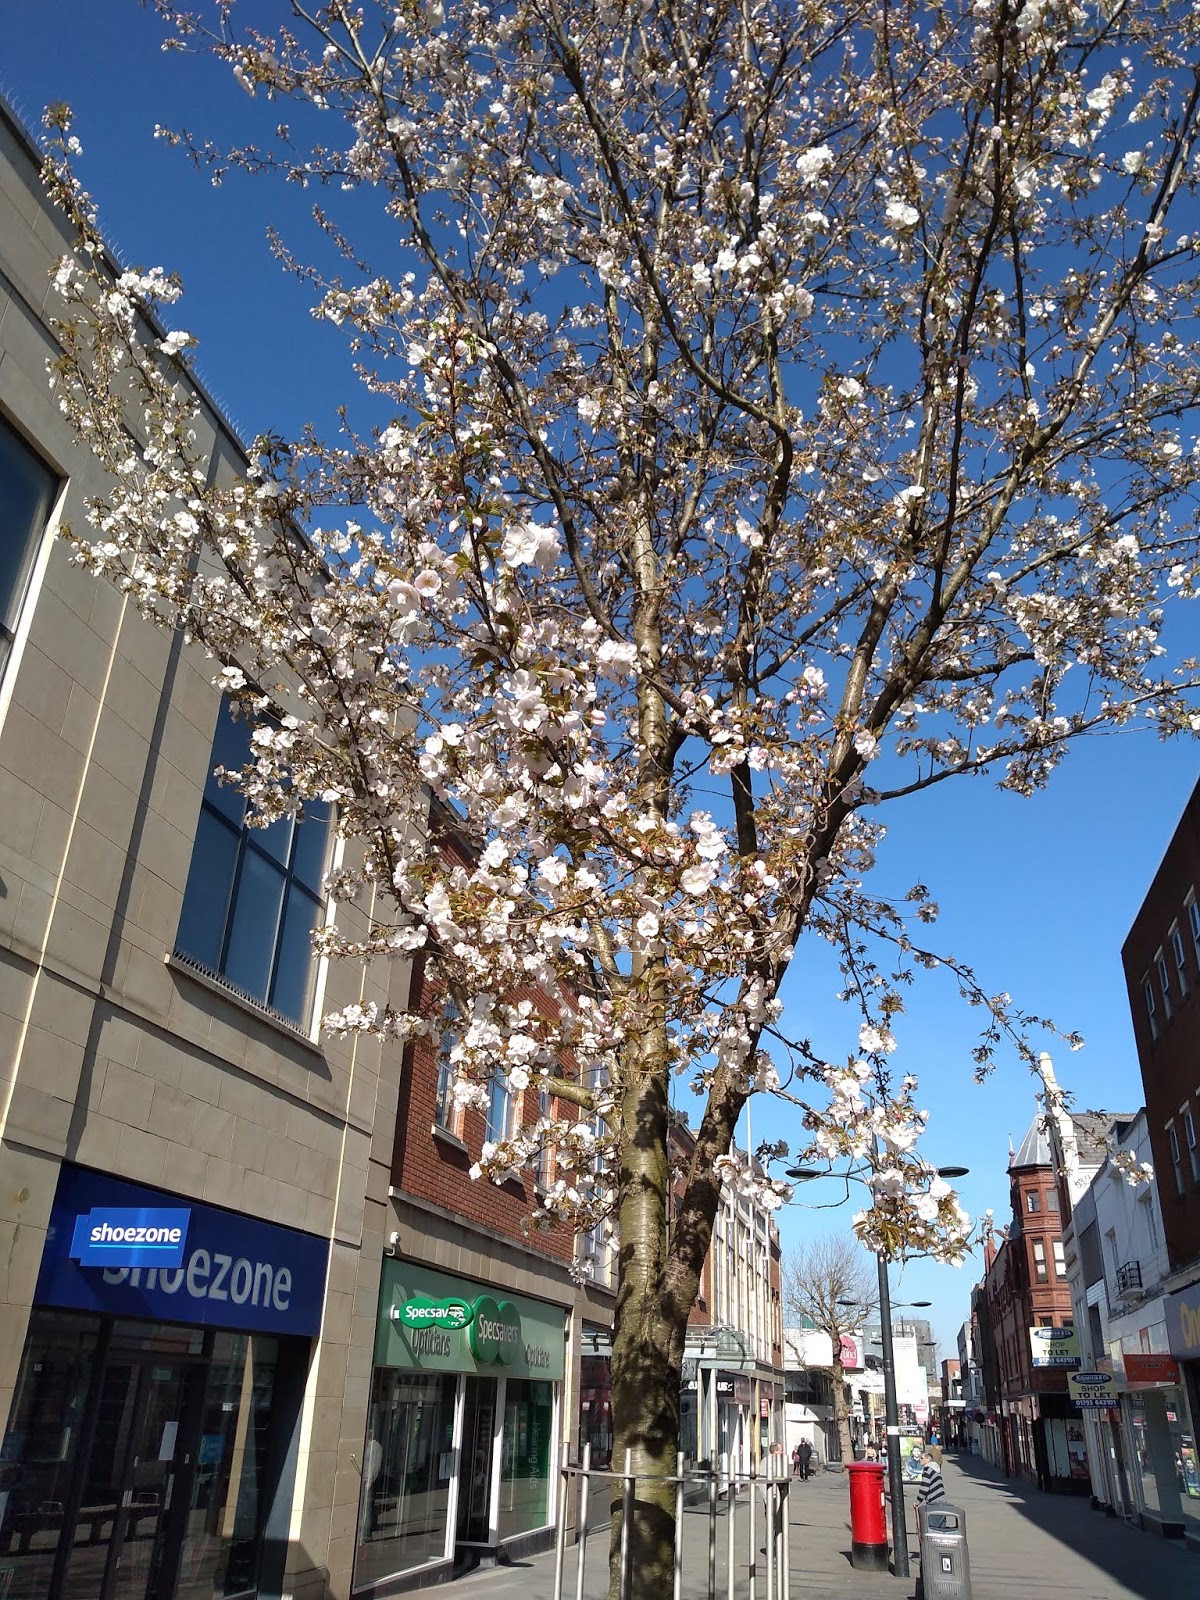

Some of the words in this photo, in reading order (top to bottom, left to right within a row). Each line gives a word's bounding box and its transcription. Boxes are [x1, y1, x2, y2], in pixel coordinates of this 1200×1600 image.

[90, 1223, 181, 1243] shoezone
[102, 1248, 292, 1311] oezone
[405, 1305, 465, 1321] Specsav
[478, 1313, 519, 1344] Specsavers
[525, 1343, 550, 1369] Opticians
[528, 1422, 542, 1463] Hearing
[529, 1470, 540, 1490] Aids
